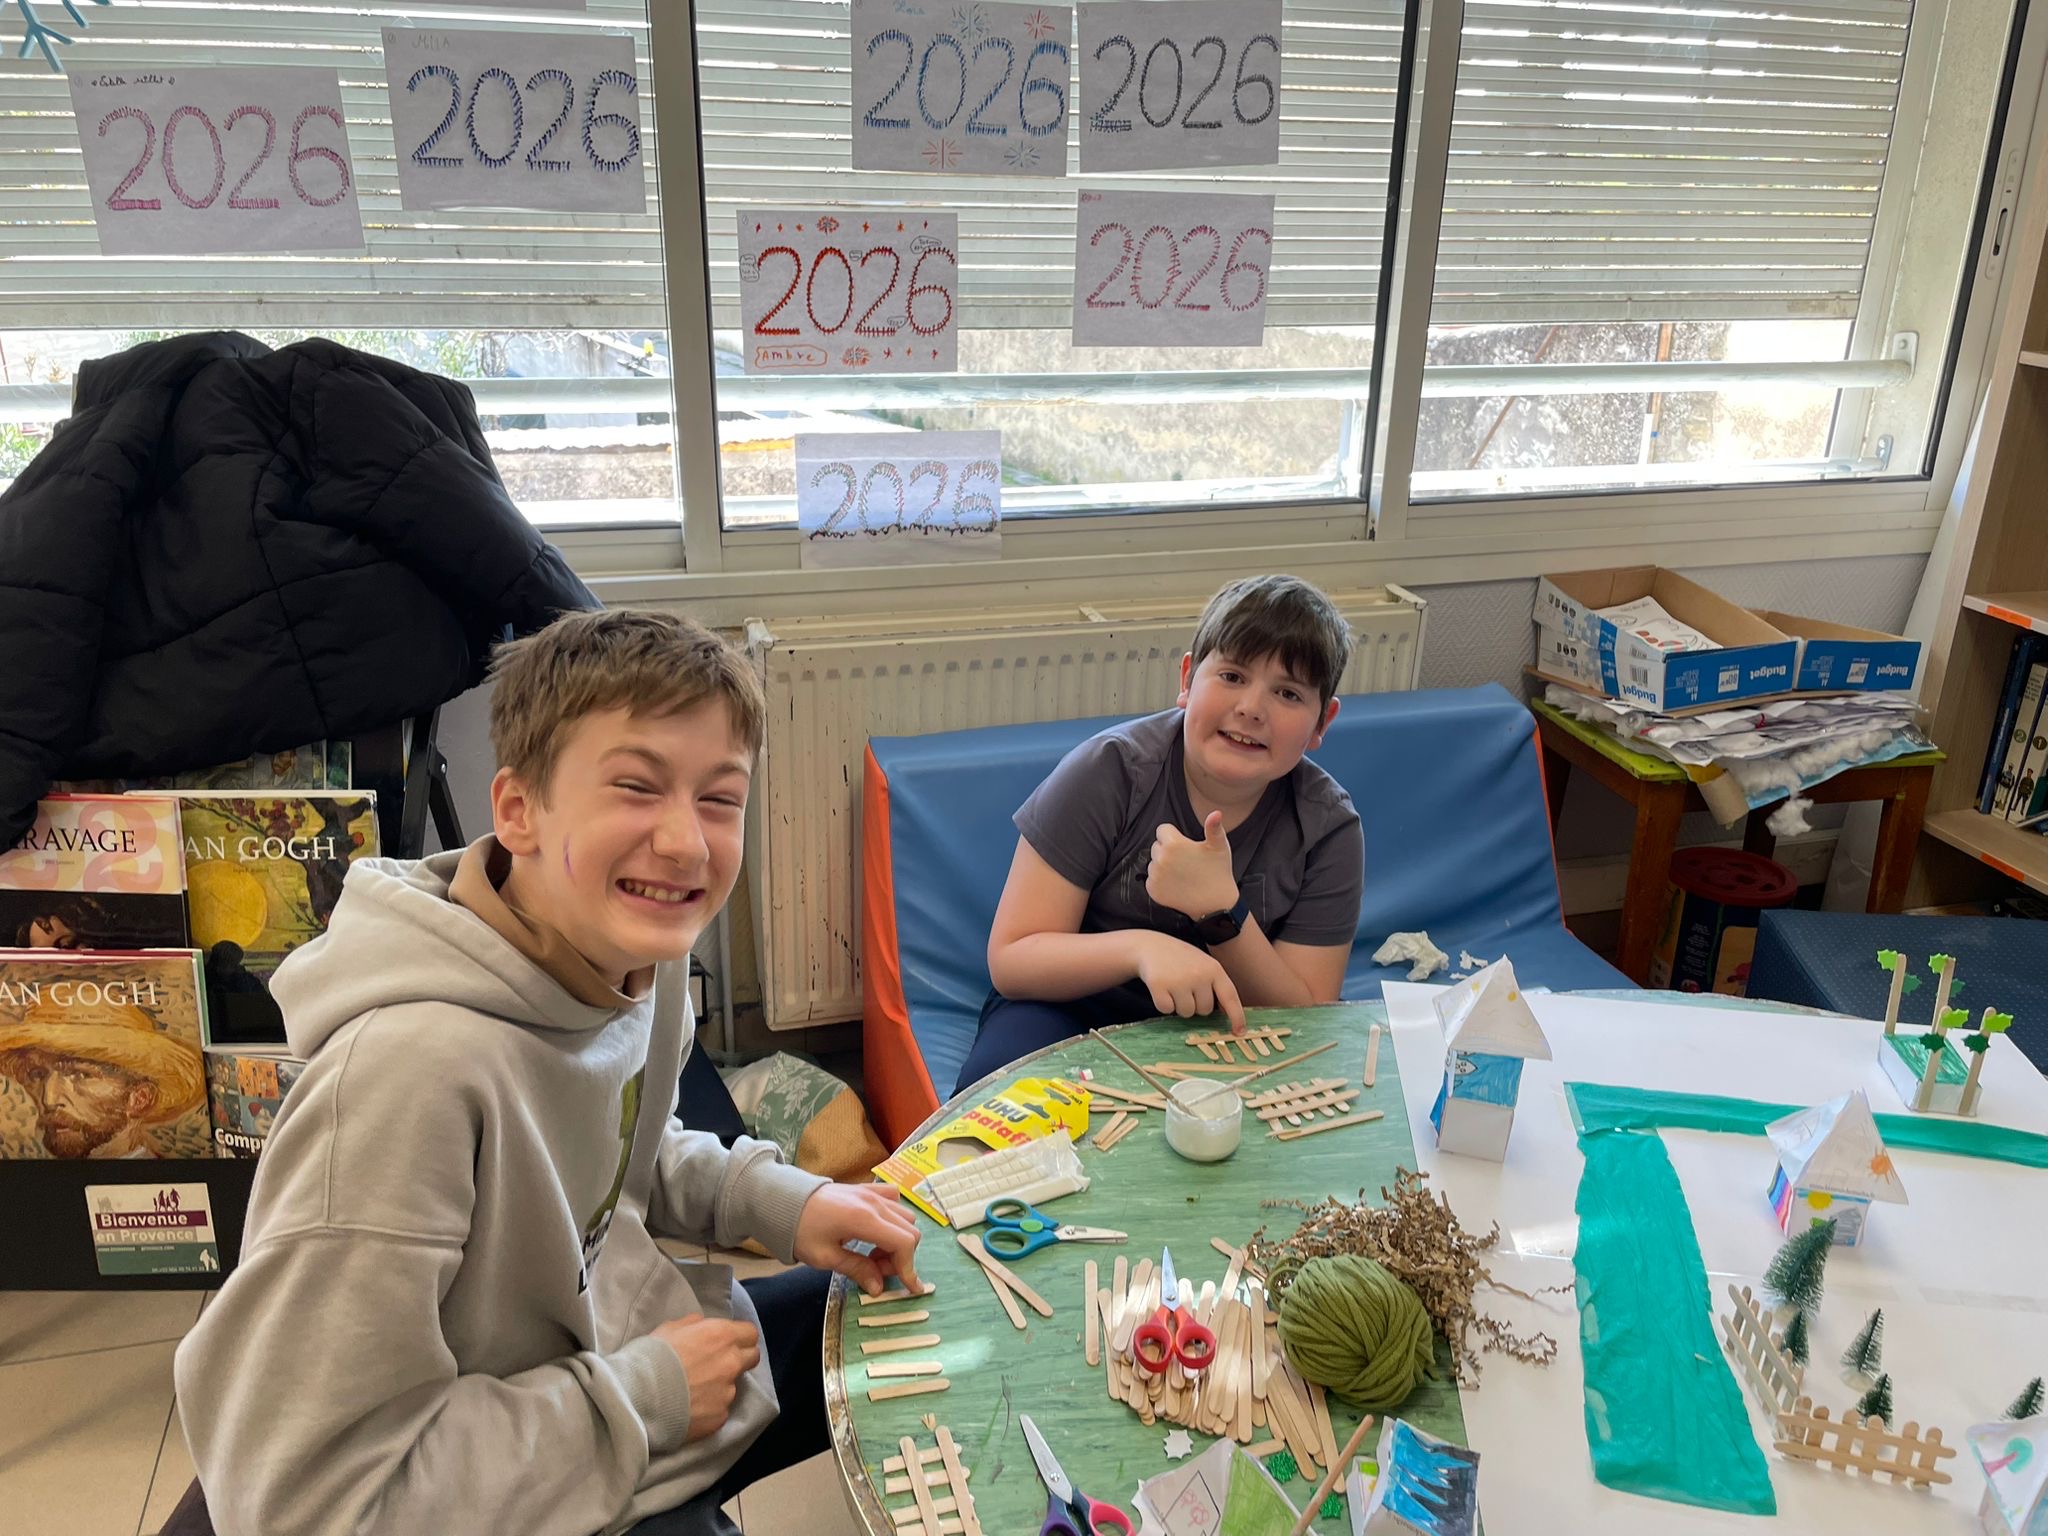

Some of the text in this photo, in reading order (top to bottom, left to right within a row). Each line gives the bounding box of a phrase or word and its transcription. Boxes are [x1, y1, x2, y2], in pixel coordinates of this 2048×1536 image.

[863, 29, 1070, 137] 2026
[1090, 33, 1279, 131] 2026
[407, 65, 639, 172] 2026
[98, 105, 350, 210] 2026
[1086, 222, 1272, 312] 2026
[755, 246, 956, 336] 2026
[808, 460, 1000, 541] 2026
[1749, 665, 1787, 680] Budget
[1876, 664, 1909, 676] Budget
[1622, 684, 1657, 704] Budget
[12, 827, 137, 853] RAVAGE
[238, 836, 337, 861] GOGH
[50, 981, 159, 1007] GOGH
[984, 1099, 1028, 1123] UHU
[100, 1213, 188, 1228] Bienvenue
[96, 1230, 194, 1243] en Provence
